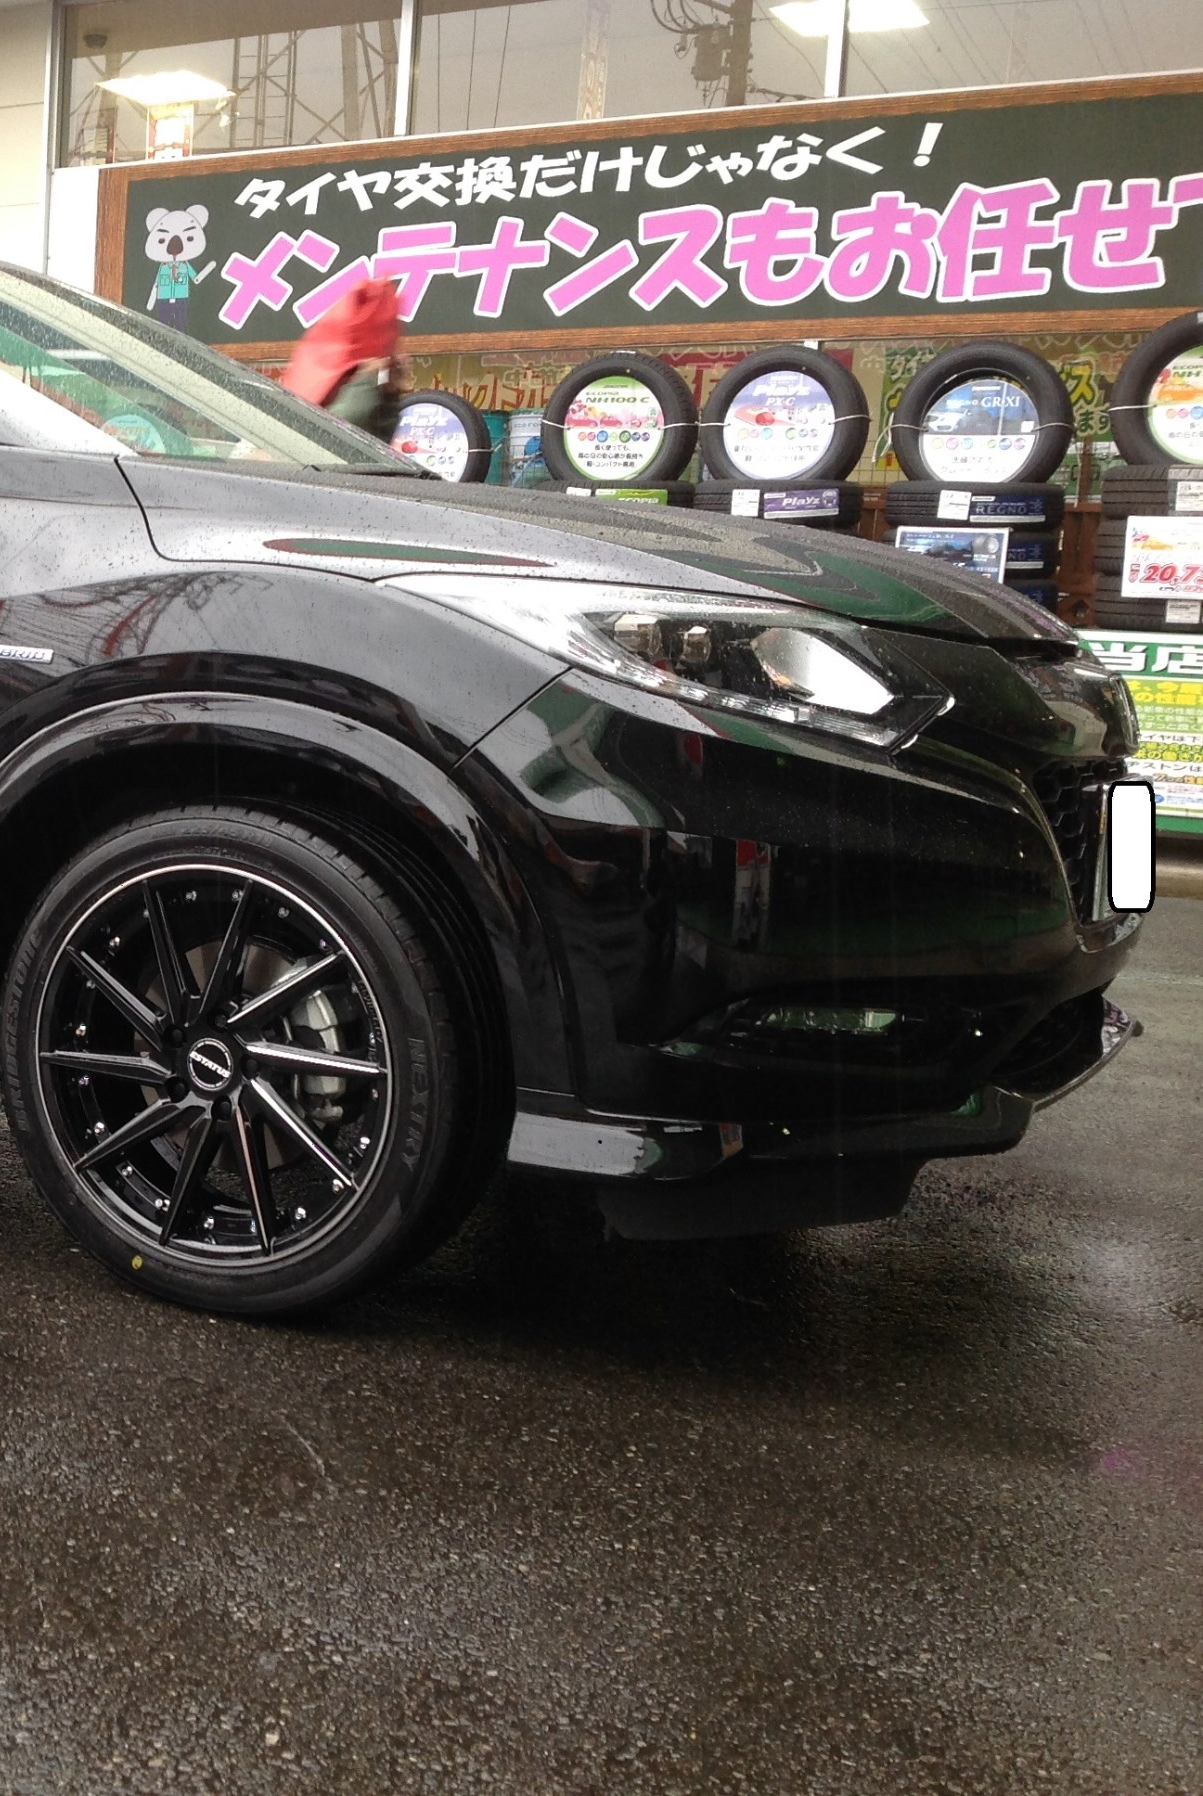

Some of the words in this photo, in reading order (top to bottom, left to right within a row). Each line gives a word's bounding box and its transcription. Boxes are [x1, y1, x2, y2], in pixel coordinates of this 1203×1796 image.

[235, 122, 943, 218] タイヤ交換だけじゃなく！
[218, 171, 1203, 330] メンテナンスもお任せ
[585, 396, 637, 404] NH100
[639, 396, 651, 404] C
[975, 505, 1028, 516] REGNO
